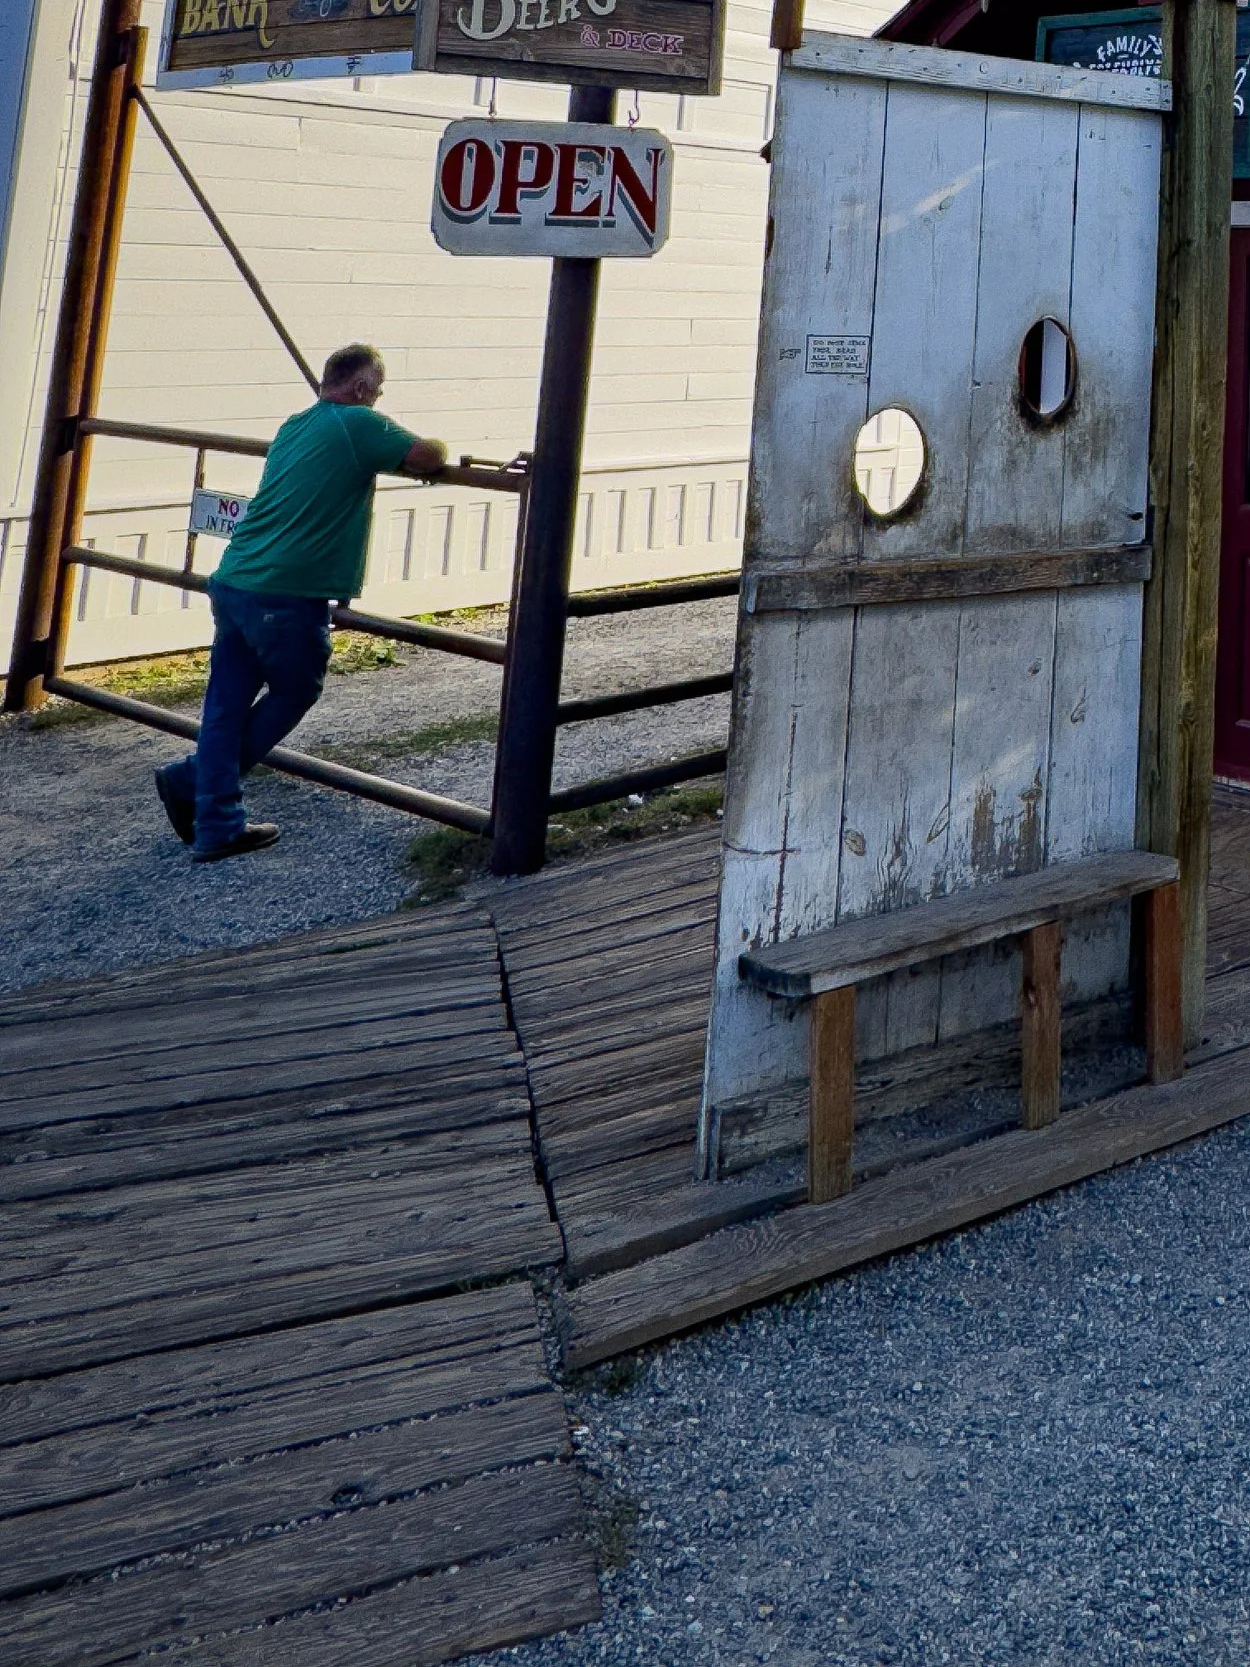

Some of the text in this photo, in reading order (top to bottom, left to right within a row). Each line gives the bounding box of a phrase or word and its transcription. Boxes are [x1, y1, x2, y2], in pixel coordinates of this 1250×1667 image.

[580, 24, 684, 54] & DECK
[440, 138, 664, 242] OPEN
[218, 498, 240, 518] NO
[220, 518, 236, 534] FR
